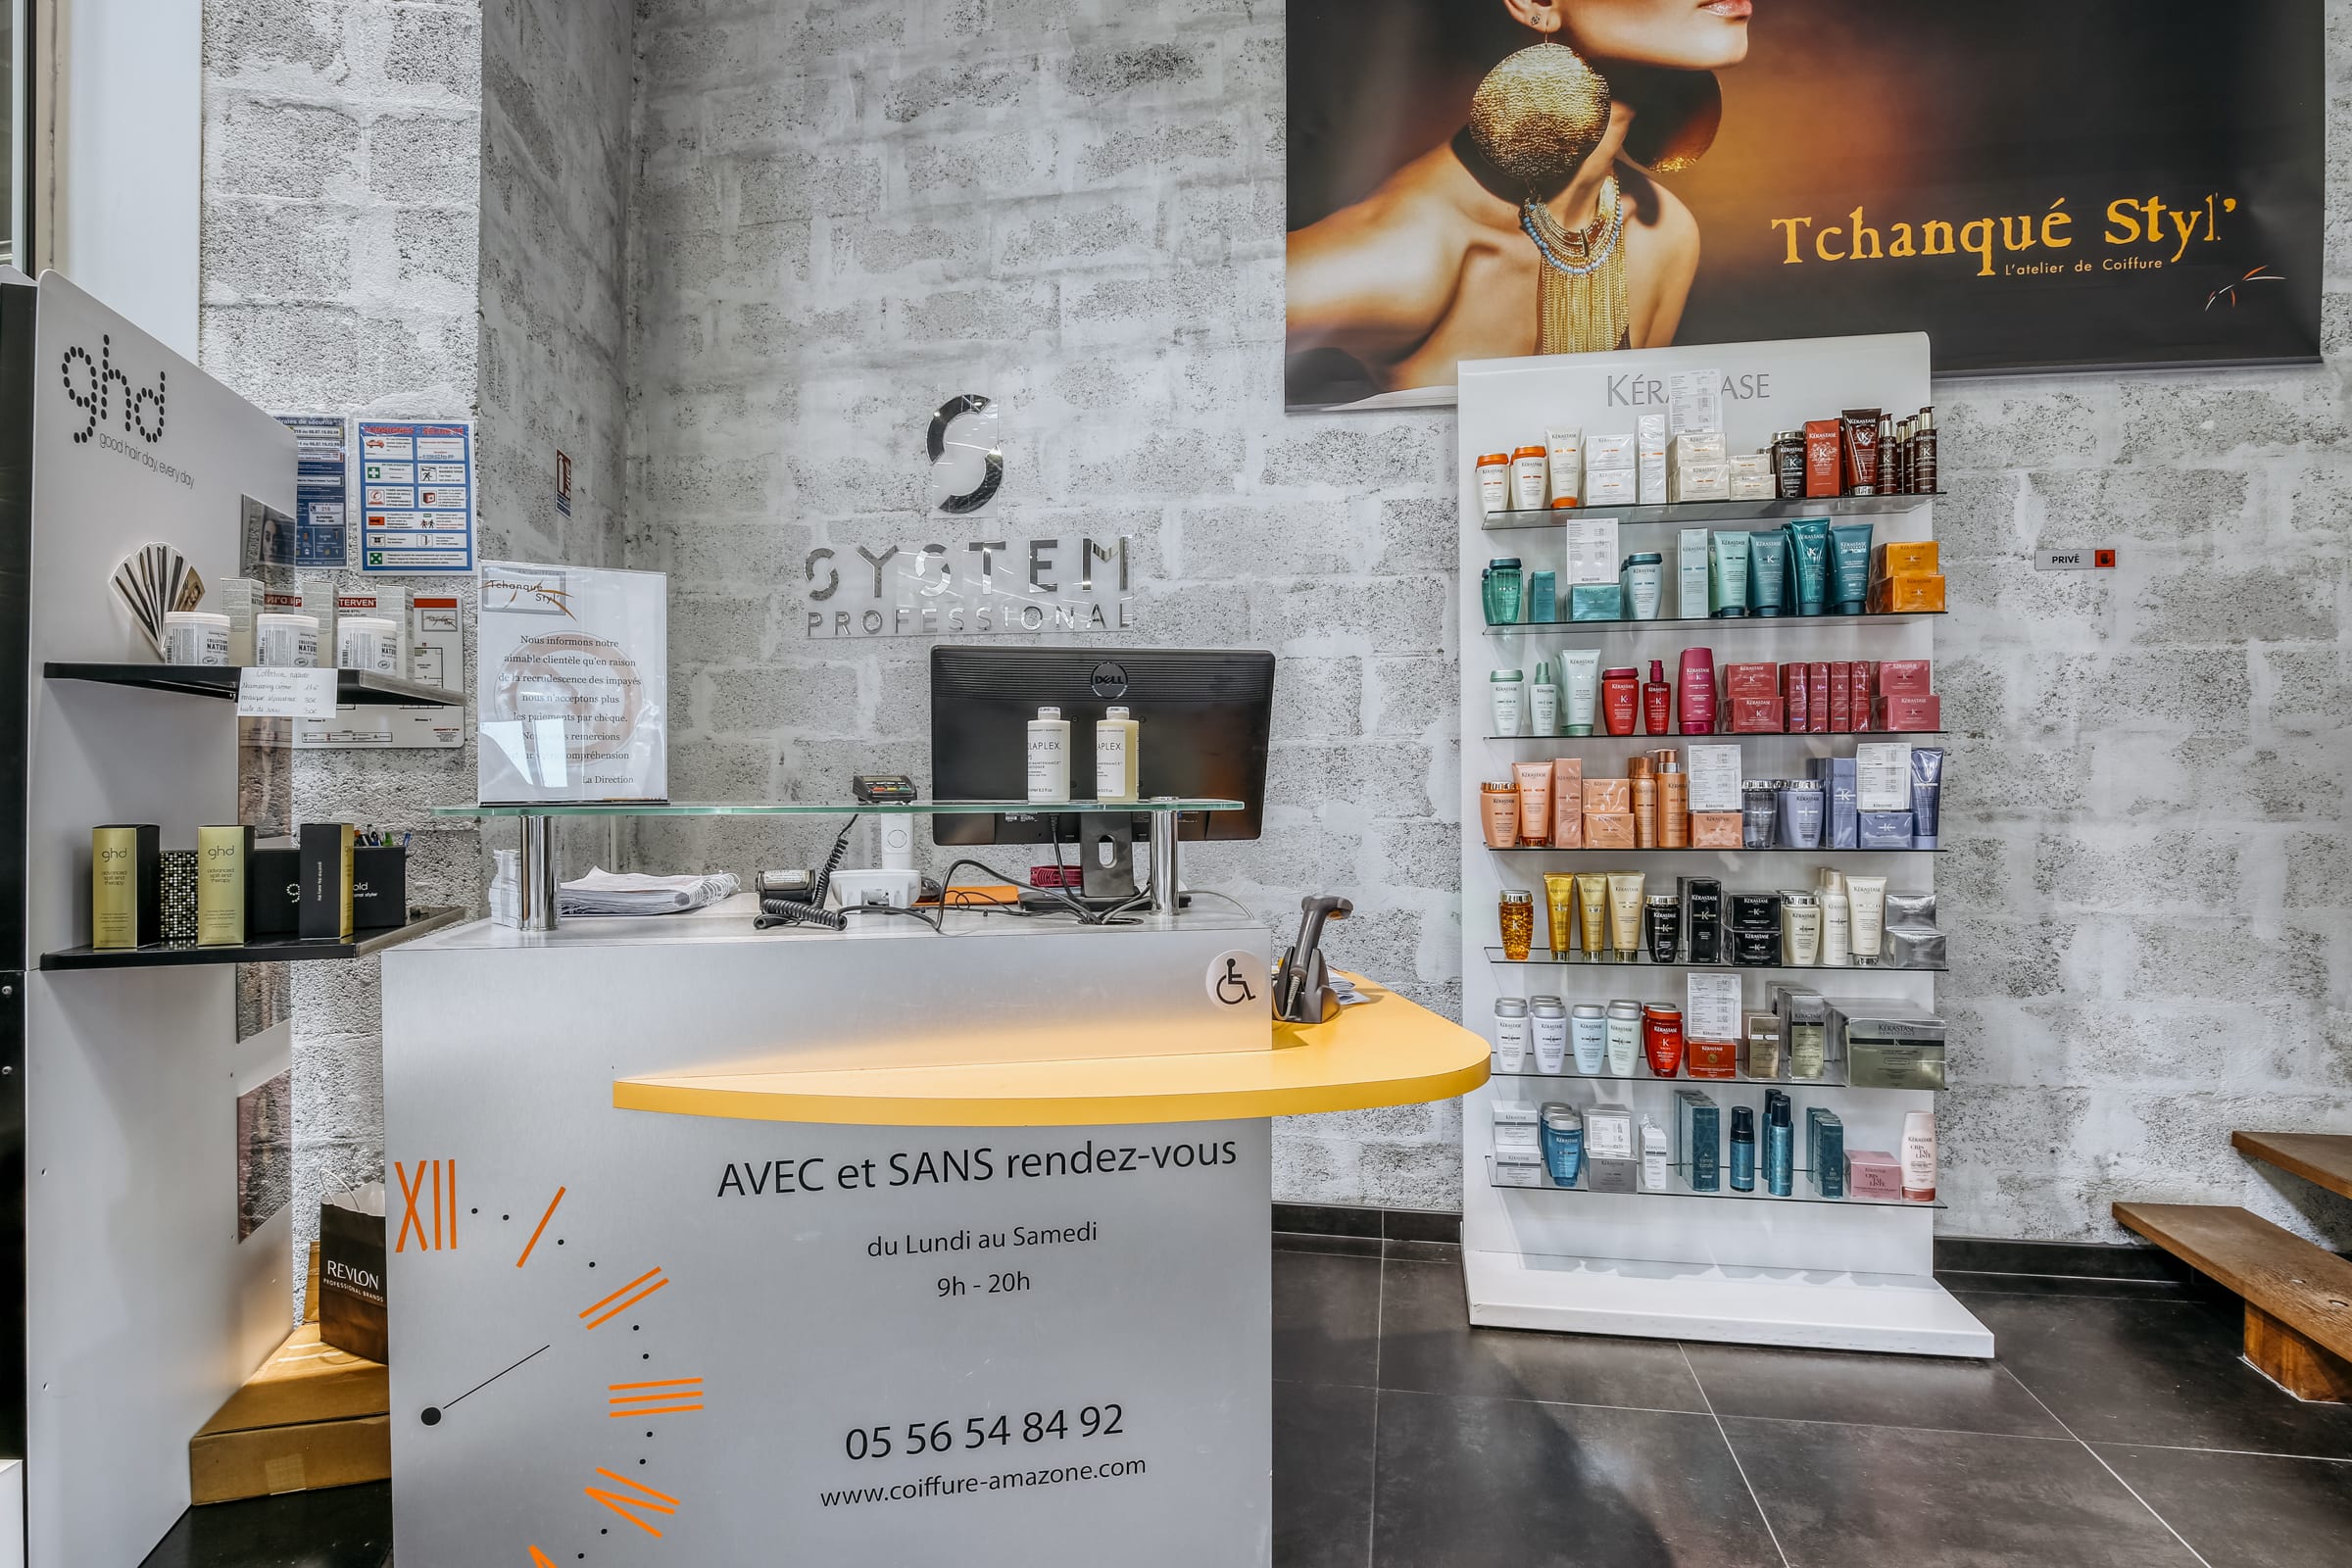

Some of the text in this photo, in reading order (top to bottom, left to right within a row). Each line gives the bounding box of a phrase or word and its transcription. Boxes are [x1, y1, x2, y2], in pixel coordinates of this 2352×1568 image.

[1771, 197, 2072, 276] Tchanqué
[2005, 257, 2163, 276] L'atelier de Coiffure
[62, 333, 166, 443] ghd
[100, 433, 123, 454] good
[124, 441, 141, 462] hair
[159, 462, 180, 483] every
[180, 470, 195, 490] day
[804, 536, 1129, 601] SYSTEM
[2051, 554, 2080, 564] PRIVÉ
[807, 603, 1132, 637] PROFESSIONAL
[520, 635, 619, 648] Nous informons notre
[504, 655, 636, 667] aimable clientèle qu'en raison
[498, 673, 511, 682] de
[522, 674, 588, 684] recrudescence
[589, 675, 604, 684] des
[606, 675, 642, 688] impayés
[1095, 674, 1124, 685] DELL
[547, 694, 599, 706] n'acceptons
[601, 695, 620, 706] plus
[514, 711, 526, 720] les
[594, 712, 628, 723] chèque.
[571, 731, 620, 741] remercions
[566, 751, 629, 761] ompréhension
[582, 774, 634, 784] La Direction
[102, 848, 127, 862] ghd
[208, 845, 235, 860] ghd
[717, 1139, 1238, 1198] AVEC et SANS rendez-vous
[394, 1158, 458, 1253] XII
[867, 1220, 1098, 1257] du Lundi au Samedi
[327, 1259, 379, 1291] REVLON
[937, 1275, 966, 1298] 9h
[988, 1271, 1031, 1295] 20h
[323, 1277, 384, 1302] PROFESSIONAL BRANDS
[845, 1403, 1124, 1460] 05 56 54 84 92
[820, 1458, 1147, 1507] www.coiffure-amazone.com
